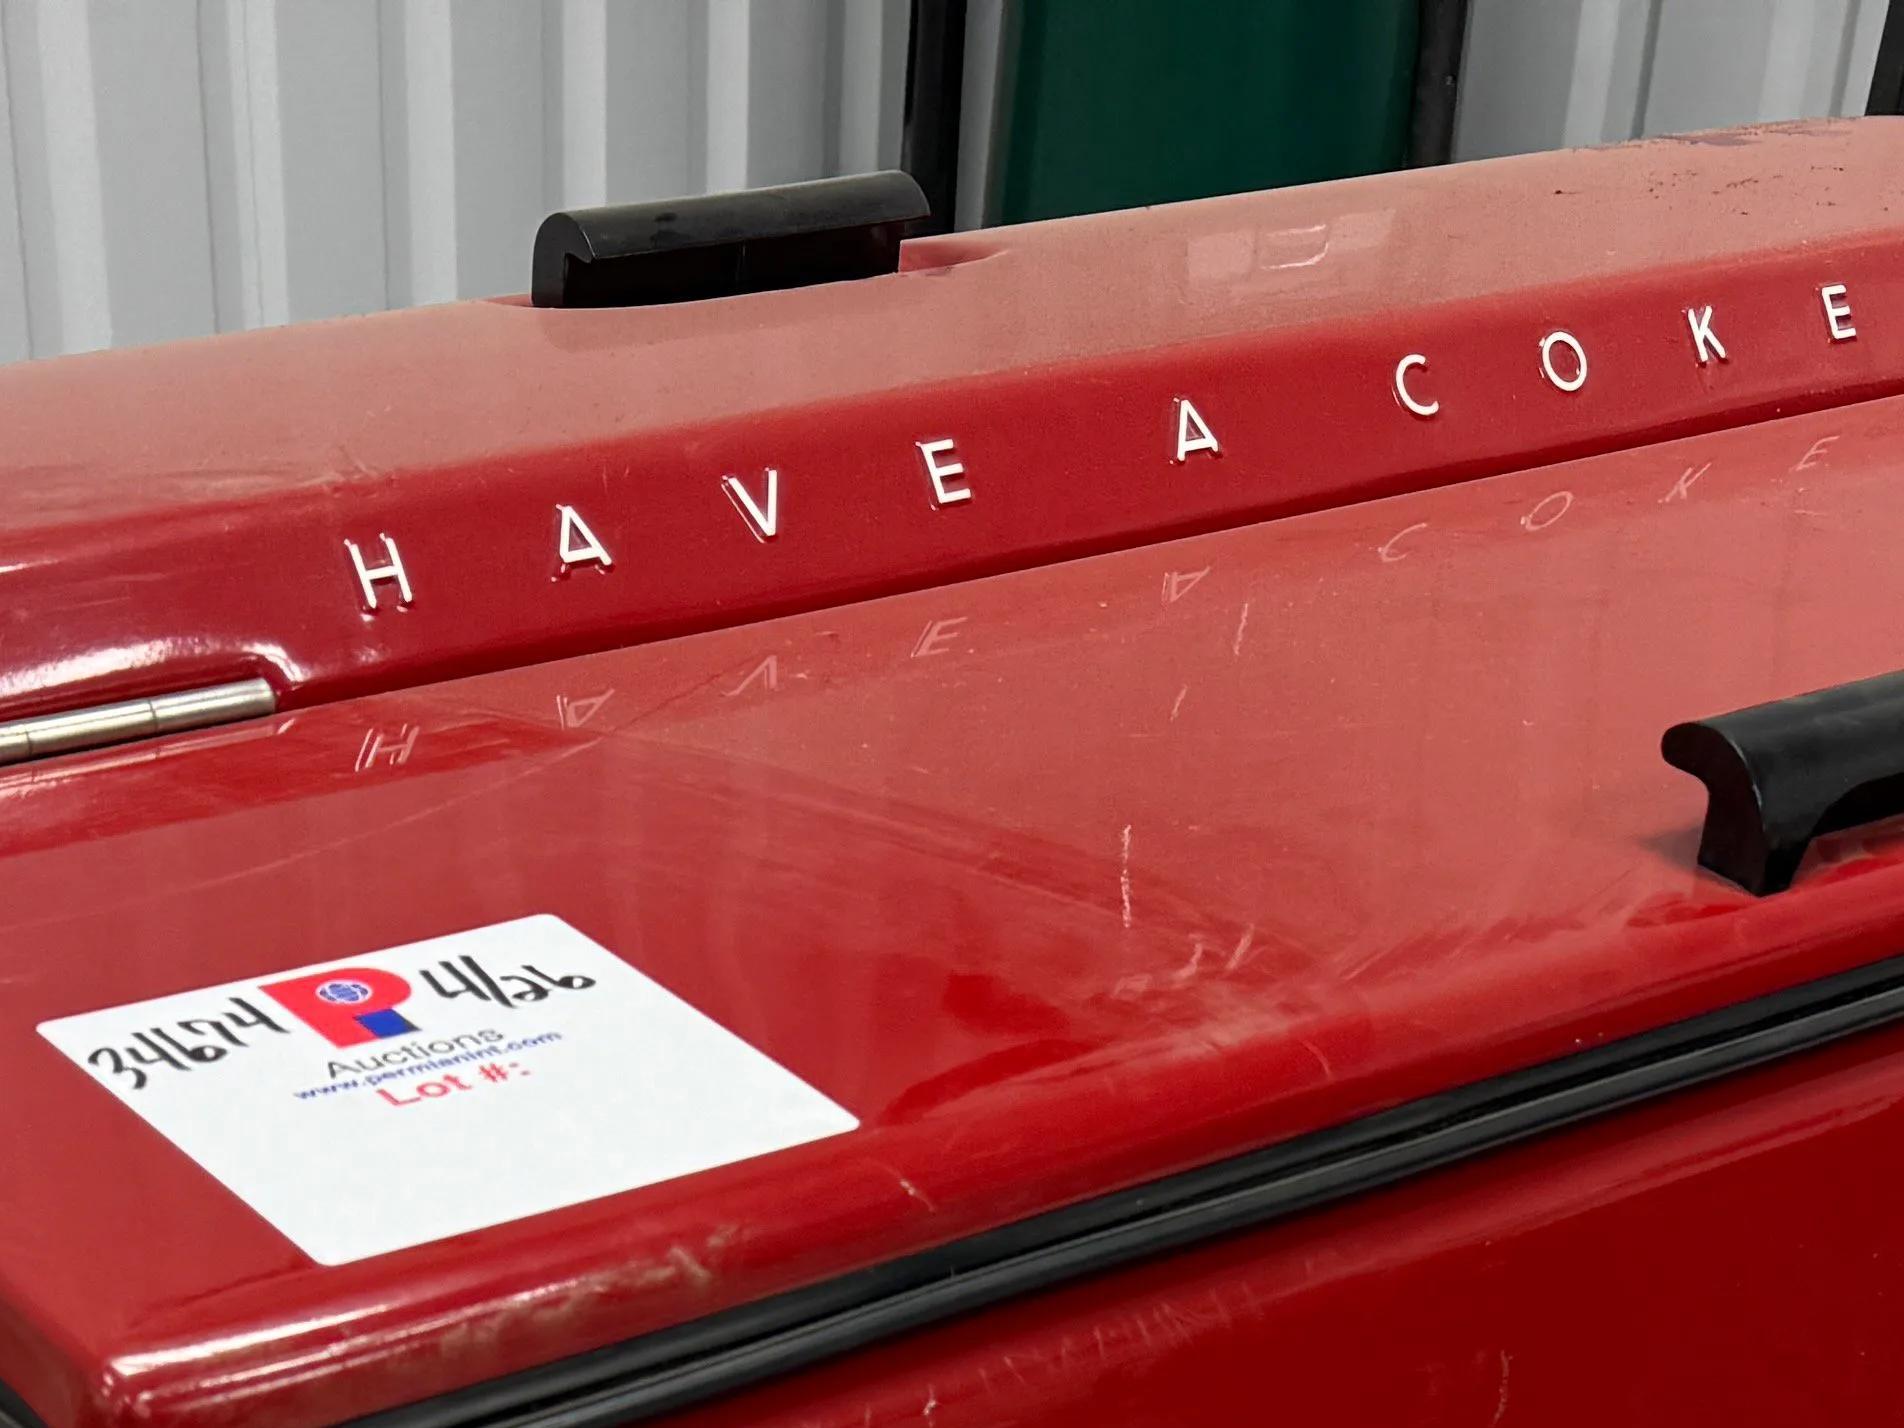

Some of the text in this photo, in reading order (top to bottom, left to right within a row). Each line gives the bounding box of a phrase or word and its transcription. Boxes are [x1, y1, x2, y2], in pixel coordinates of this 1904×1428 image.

[344, 283, 1859, 612] HAVE A COKE
[87, 996, 293, 1090] 34674
[293, 1030, 562, 1100] www.permianint.com
[327, 1029, 504, 1078] Auctions
[375, 1061, 531, 1106] Lot #:
